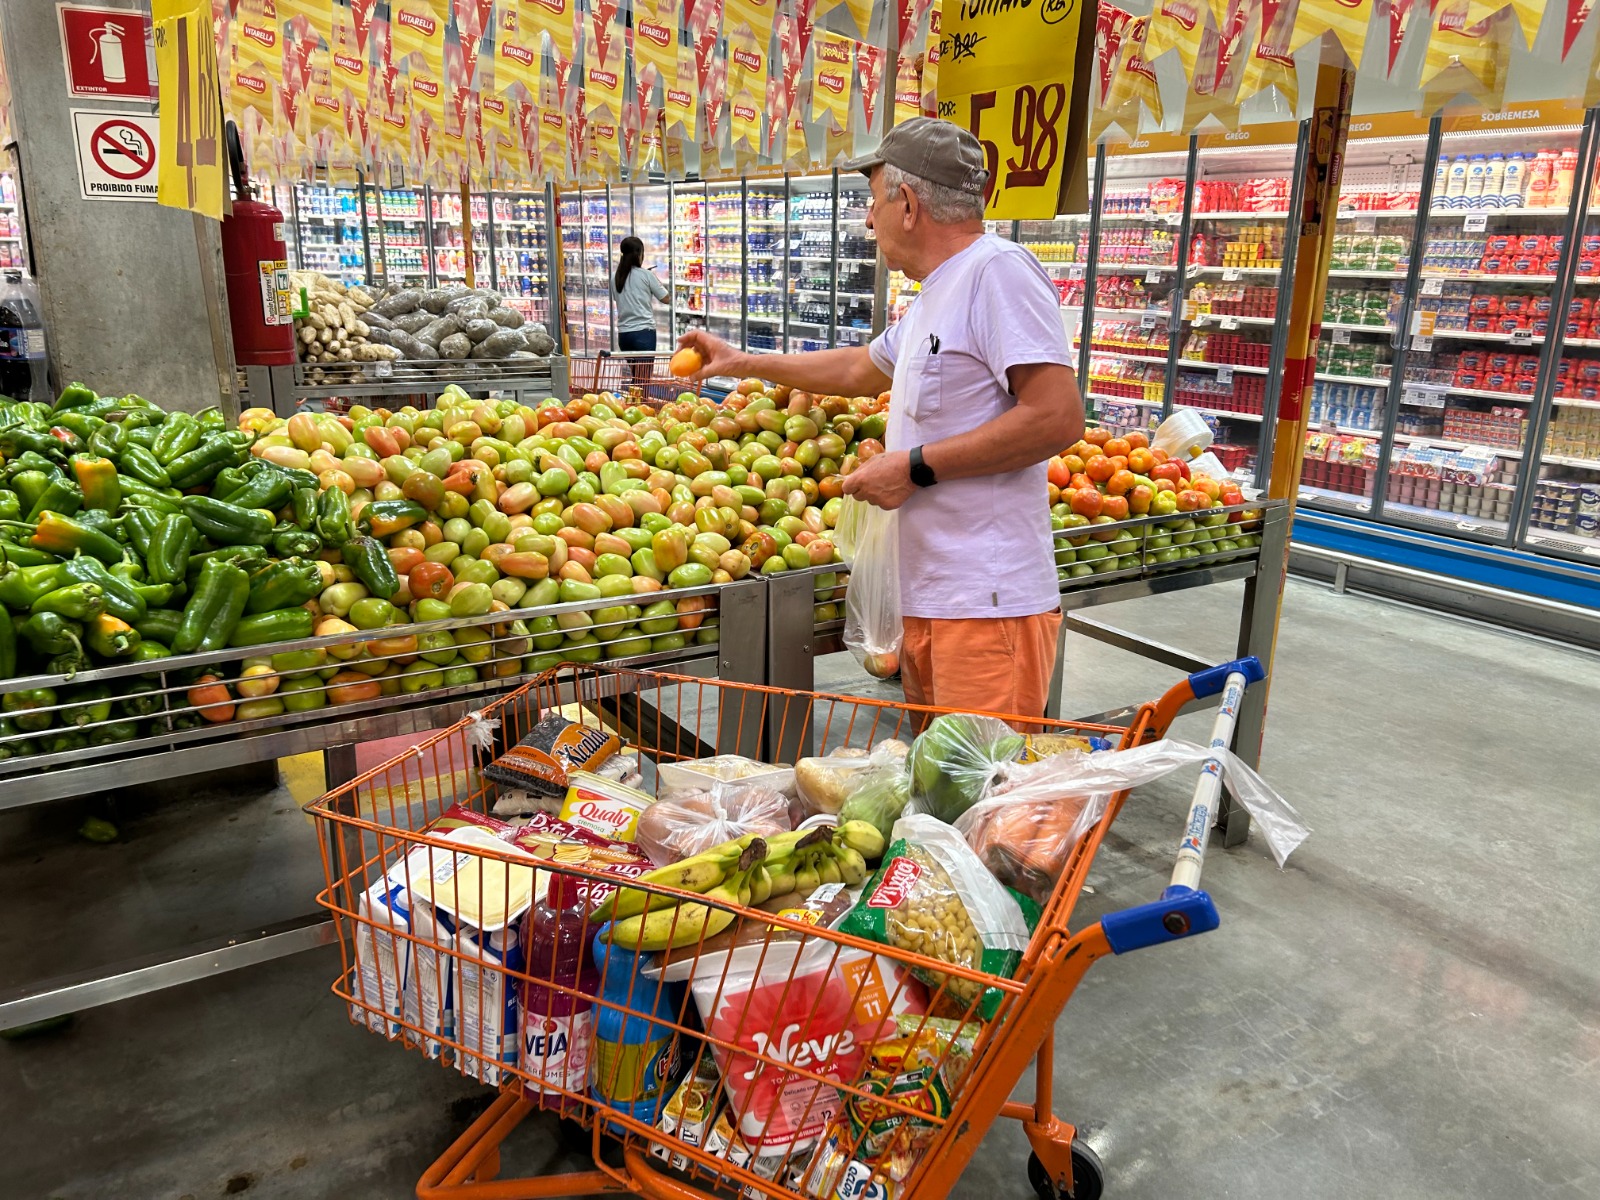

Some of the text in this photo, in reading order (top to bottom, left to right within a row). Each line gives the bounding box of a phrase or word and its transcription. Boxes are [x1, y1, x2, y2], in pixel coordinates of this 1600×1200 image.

[400, 13, 435, 30] VITARELLA
[245, 26, 273, 42] VITARELLA
[639, 24, 669, 41] VITARELLA
[504, 46, 532, 61] VITARELLA
[735, 52, 760, 67] VITARELLA
[335, 55, 363, 72] VITARELLA
[238, 76, 266, 92] VITARELLA
[591, 71, 616, 85] VITARELLA
[414, 81, 438, 94] VITARELLA
[315, 96, 340, 110] VITARELLA
[669, 91, 691, 105] VITARELLA
[938, 101, 956, 118] POR:
[1480, 109, 1541, 123] SOBREMESA
[1349, 123, 1373, 132] REGO
[1128, 139, 1150, 149] GREGO
[1225, 131, 1250, 141] GREGO
[970, 83, 1066, 208] 5,98
[90, 183, 133, 193] PROIBIDO
[578, 801, 631, 828] Qualy
[577, 819, 605, 833] cremosa
[871, 860, 917, 907] Vilma
[852, 970, 875, 987] 12
[863, 1001, 882, 1018] 11
[525, 1032, 568, 1059] VEJA
[744, 1023, 856, 1081] Neve
